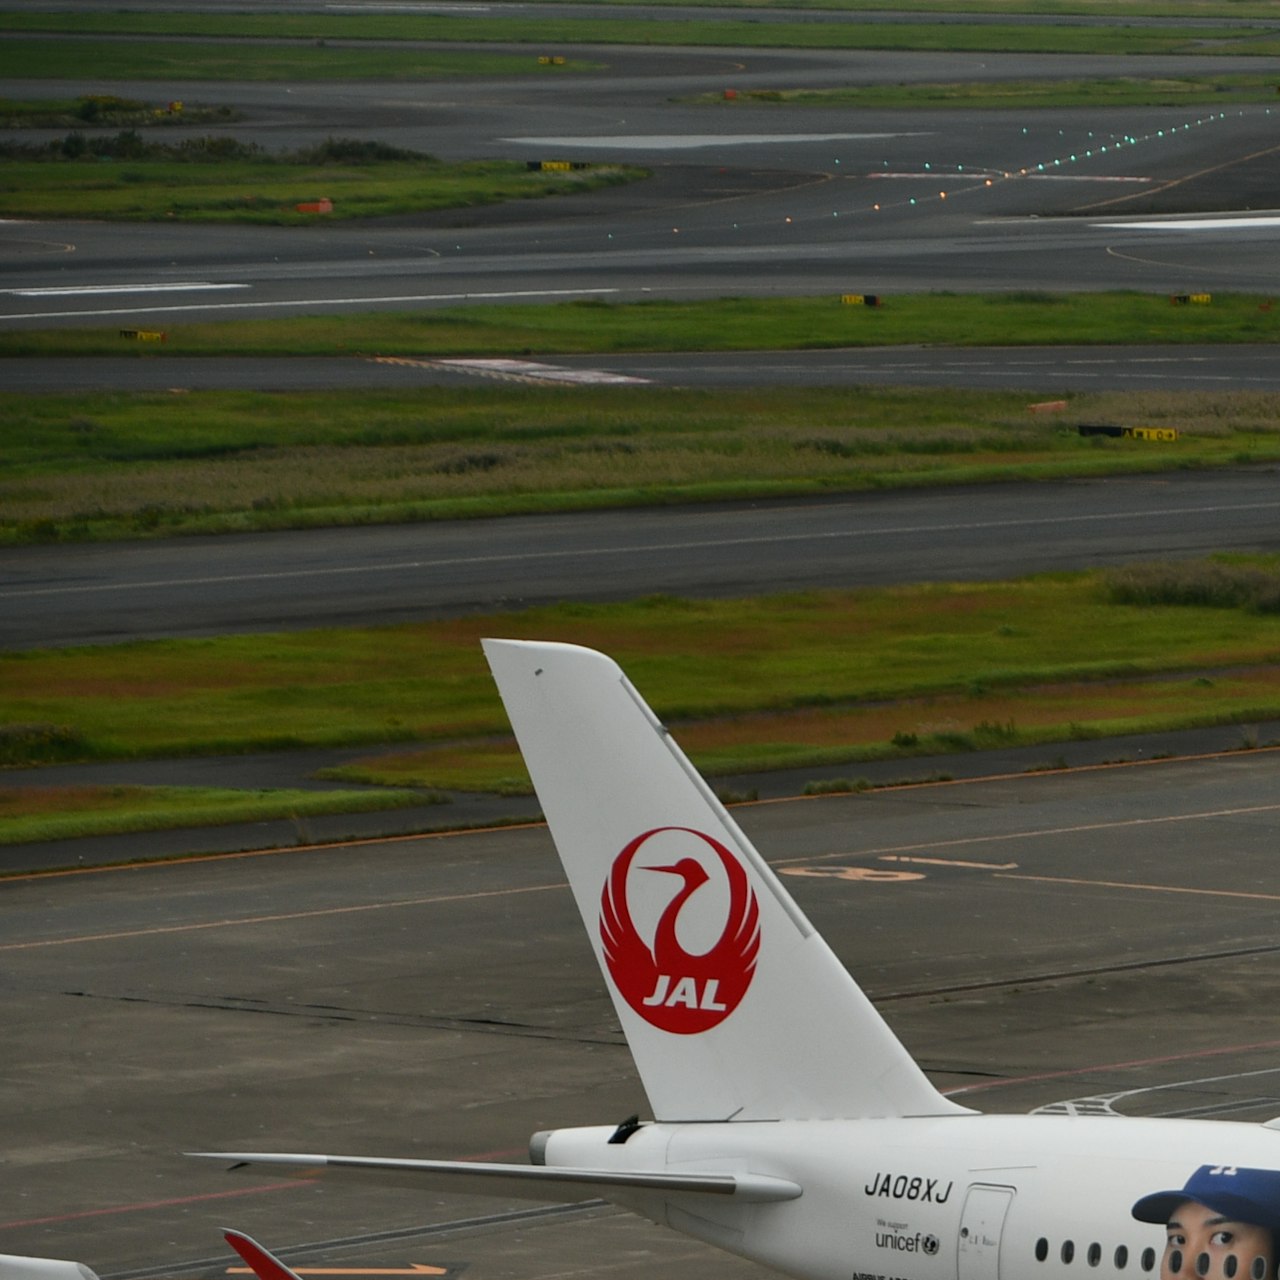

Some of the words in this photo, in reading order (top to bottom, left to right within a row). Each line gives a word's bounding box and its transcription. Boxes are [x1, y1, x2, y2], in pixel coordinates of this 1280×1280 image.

[642, 974, 727, 1012] JAL
[864, 1172, 954, 1204] JA08XJ
[875, 1229, 921, 1253] unicef
